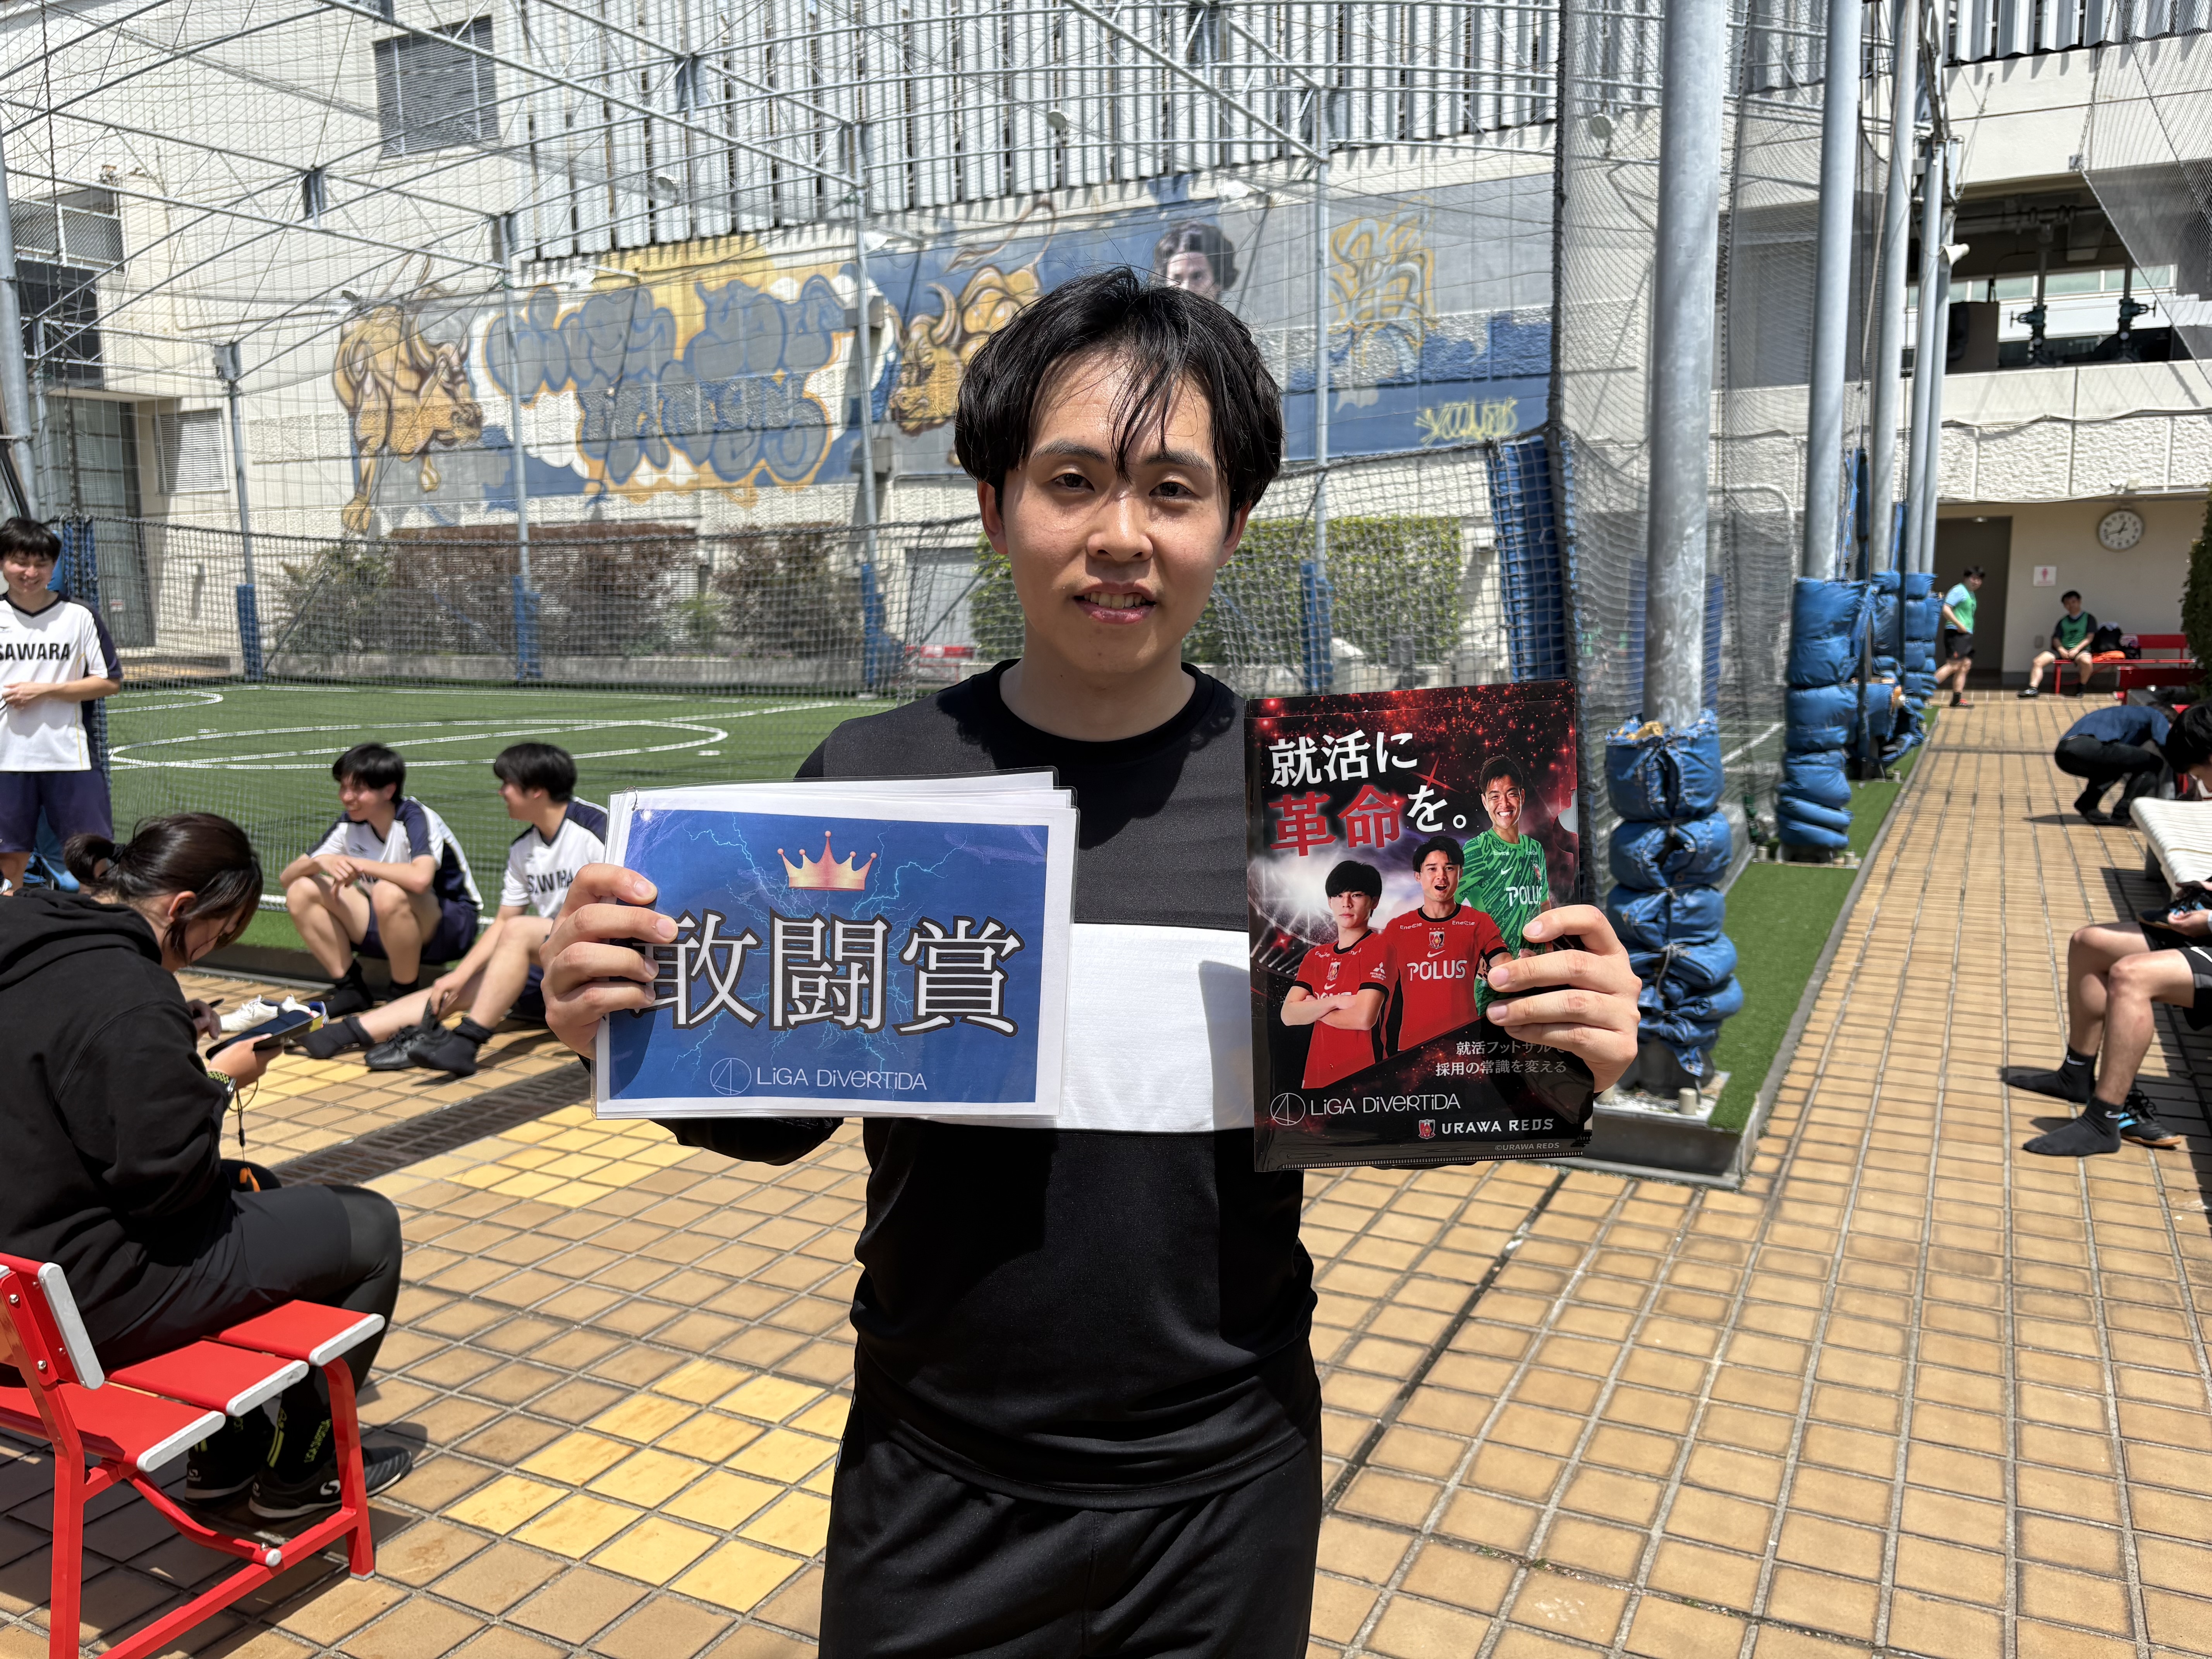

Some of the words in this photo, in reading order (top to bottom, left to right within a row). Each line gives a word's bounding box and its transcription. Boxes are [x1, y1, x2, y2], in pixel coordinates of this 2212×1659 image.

[1268, 729, 1417, 787] 就活に
[1267, 785, 1467, 856] 革命を。
[631, 908, 1025, 1036] 敢闘賞
[1407, 960, 1467, 981] POLUS
[1456, 1041, 1565, 1056] 就活フットサル
[1436, 1060, 1566, 1077] 採用の常識を変える
[1442, 1121, 1502, 1134] URAWA
[1509, 1118, 1554, 1131] REDS
